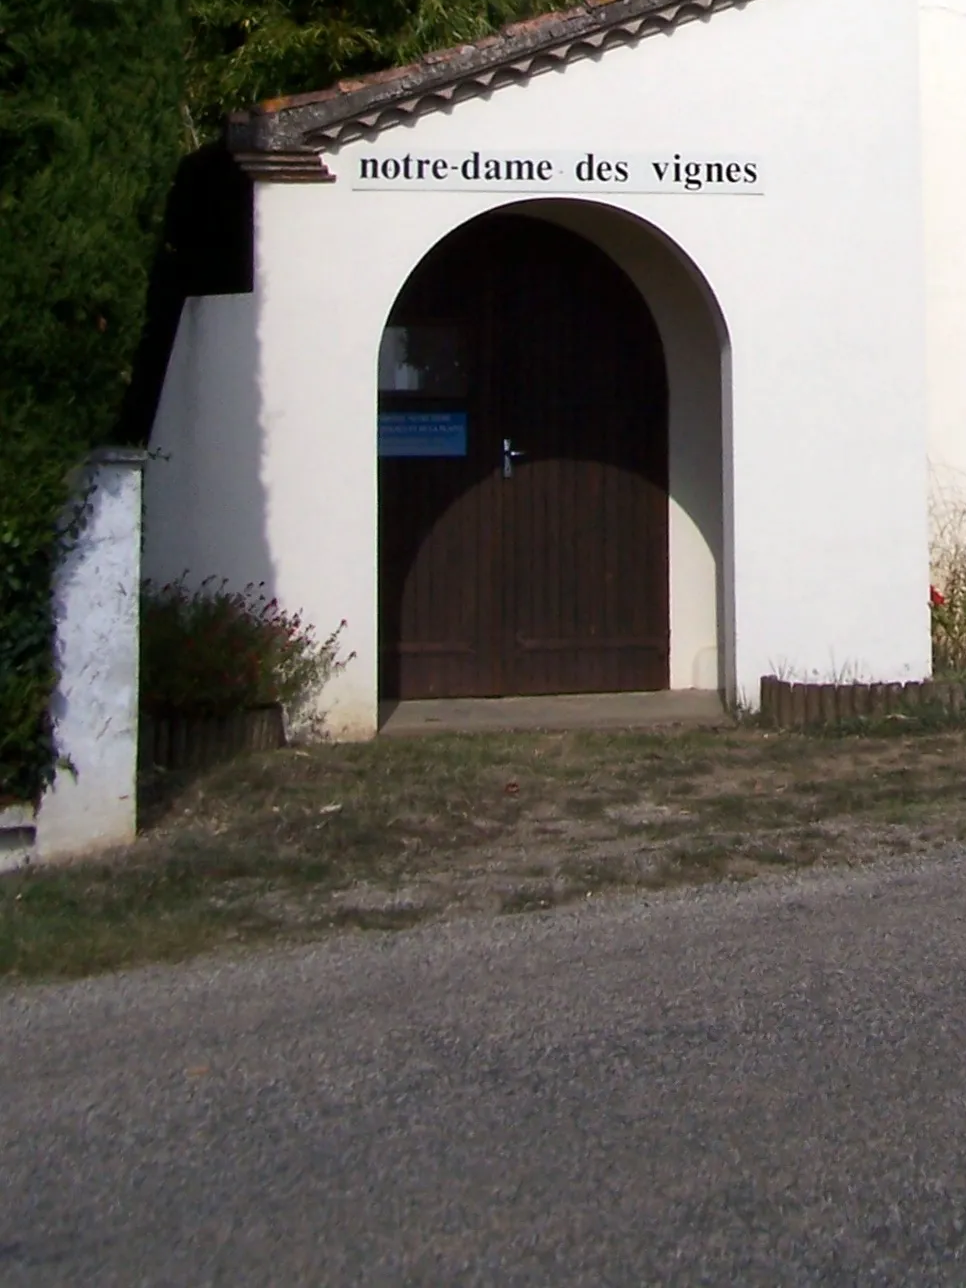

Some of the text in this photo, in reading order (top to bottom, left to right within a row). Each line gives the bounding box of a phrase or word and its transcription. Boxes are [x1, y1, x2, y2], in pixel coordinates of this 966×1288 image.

[360, 151, 758, 191] notre-dame des vignes
